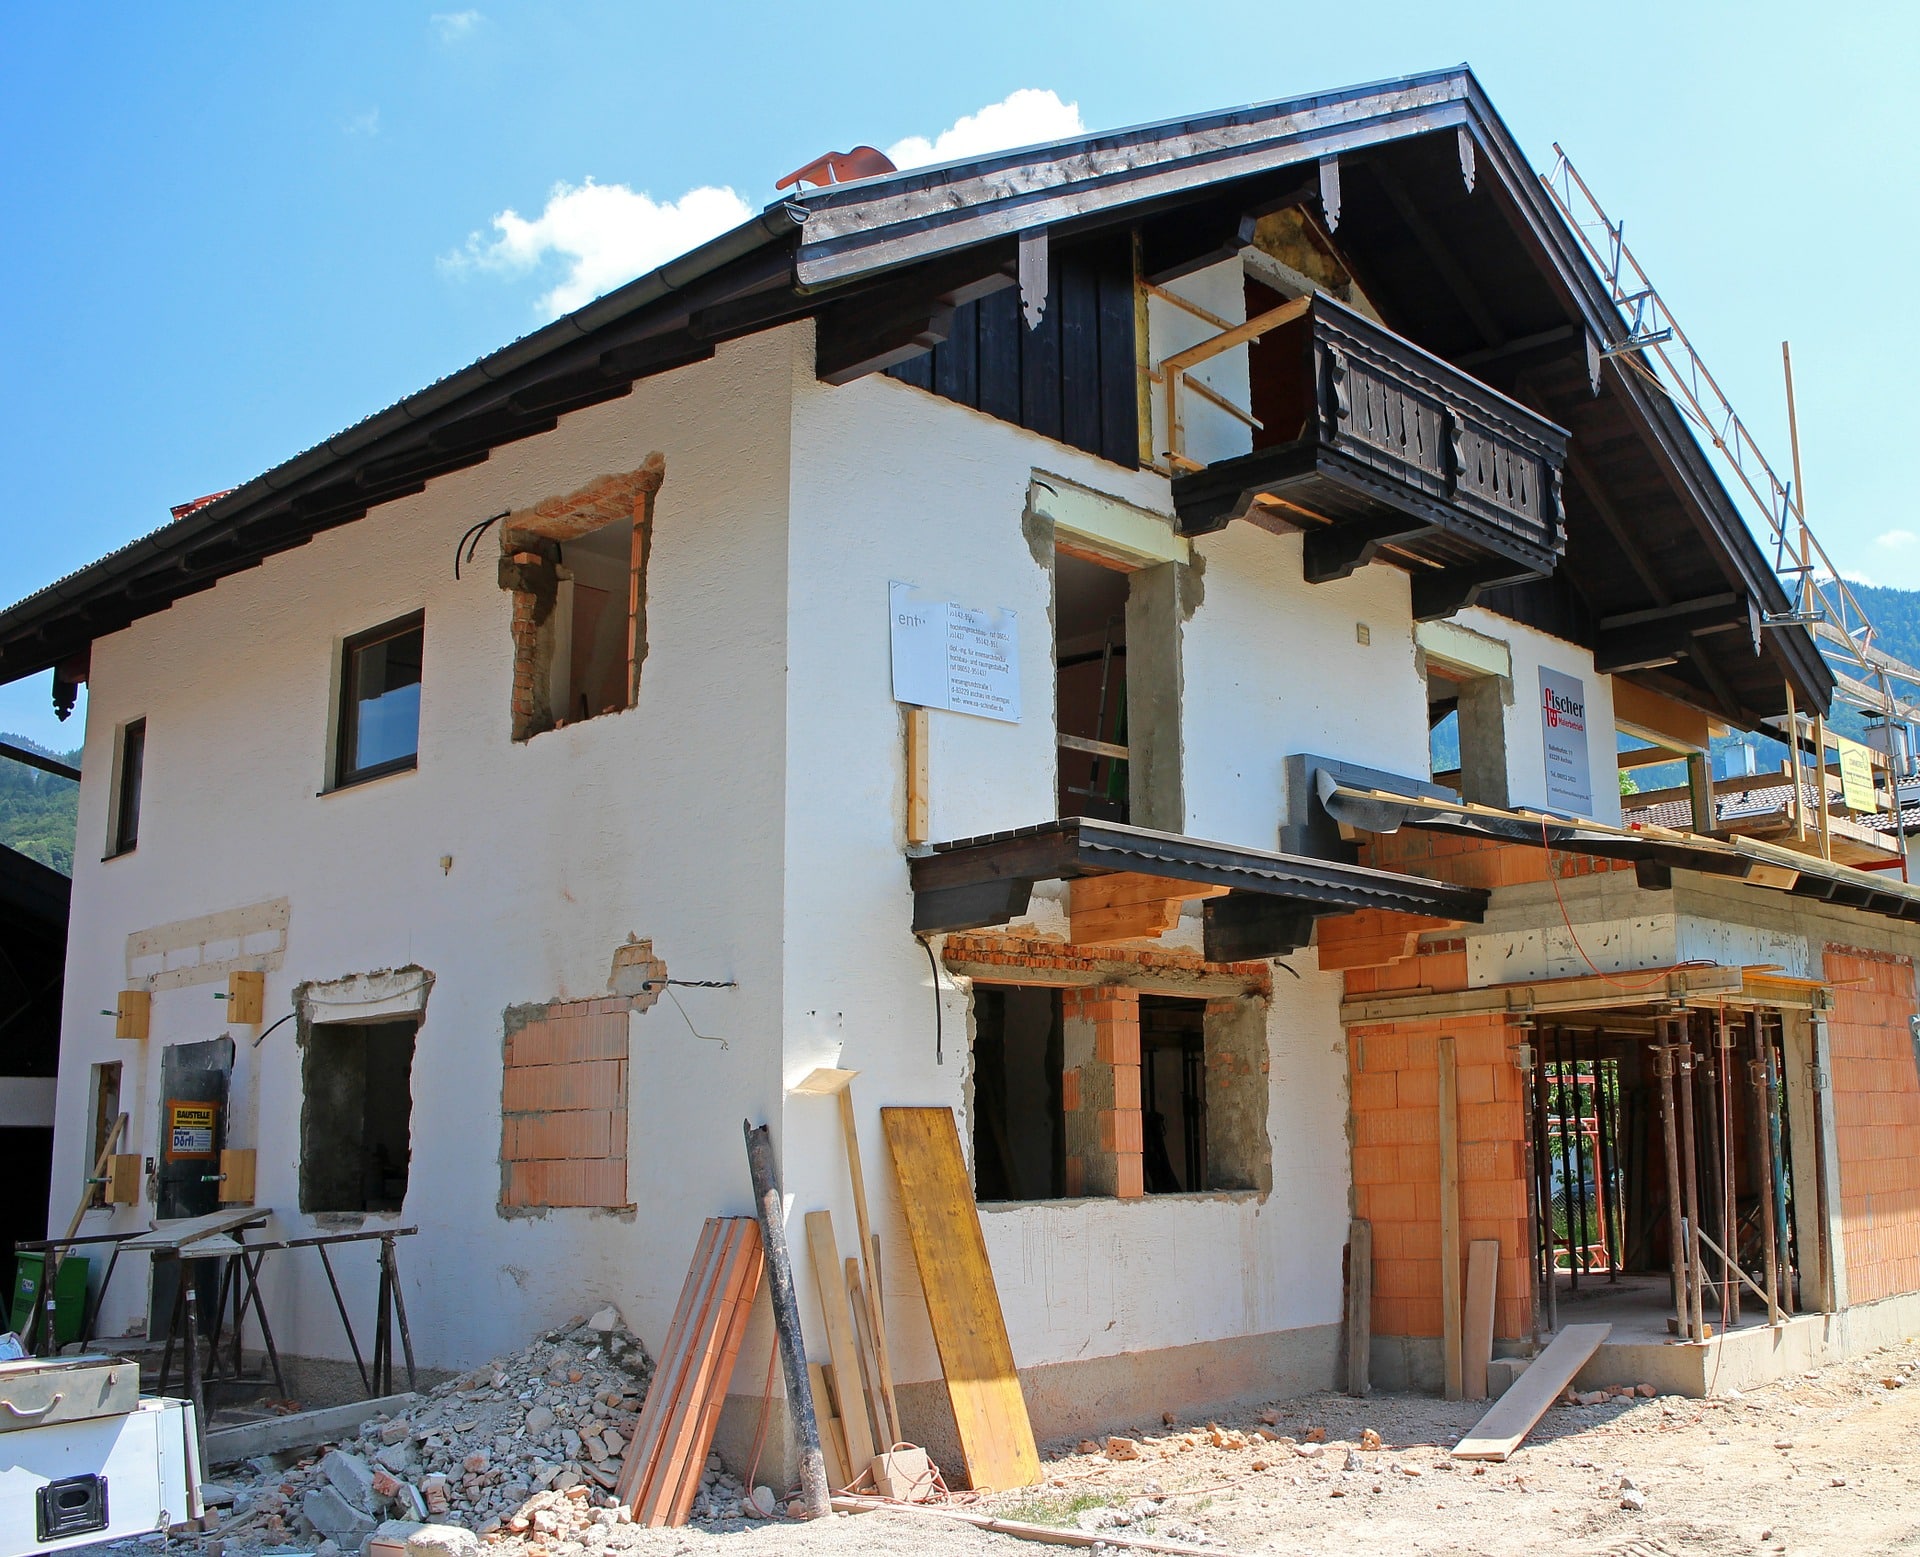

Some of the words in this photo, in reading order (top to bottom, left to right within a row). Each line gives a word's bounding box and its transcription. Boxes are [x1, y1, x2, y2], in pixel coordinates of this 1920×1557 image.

[1543, 688, 1584, 727] fischer
[176, 1110, 210, 1120] BAUSTELLE
[173, 1135, 194, 1147] Dörfl
